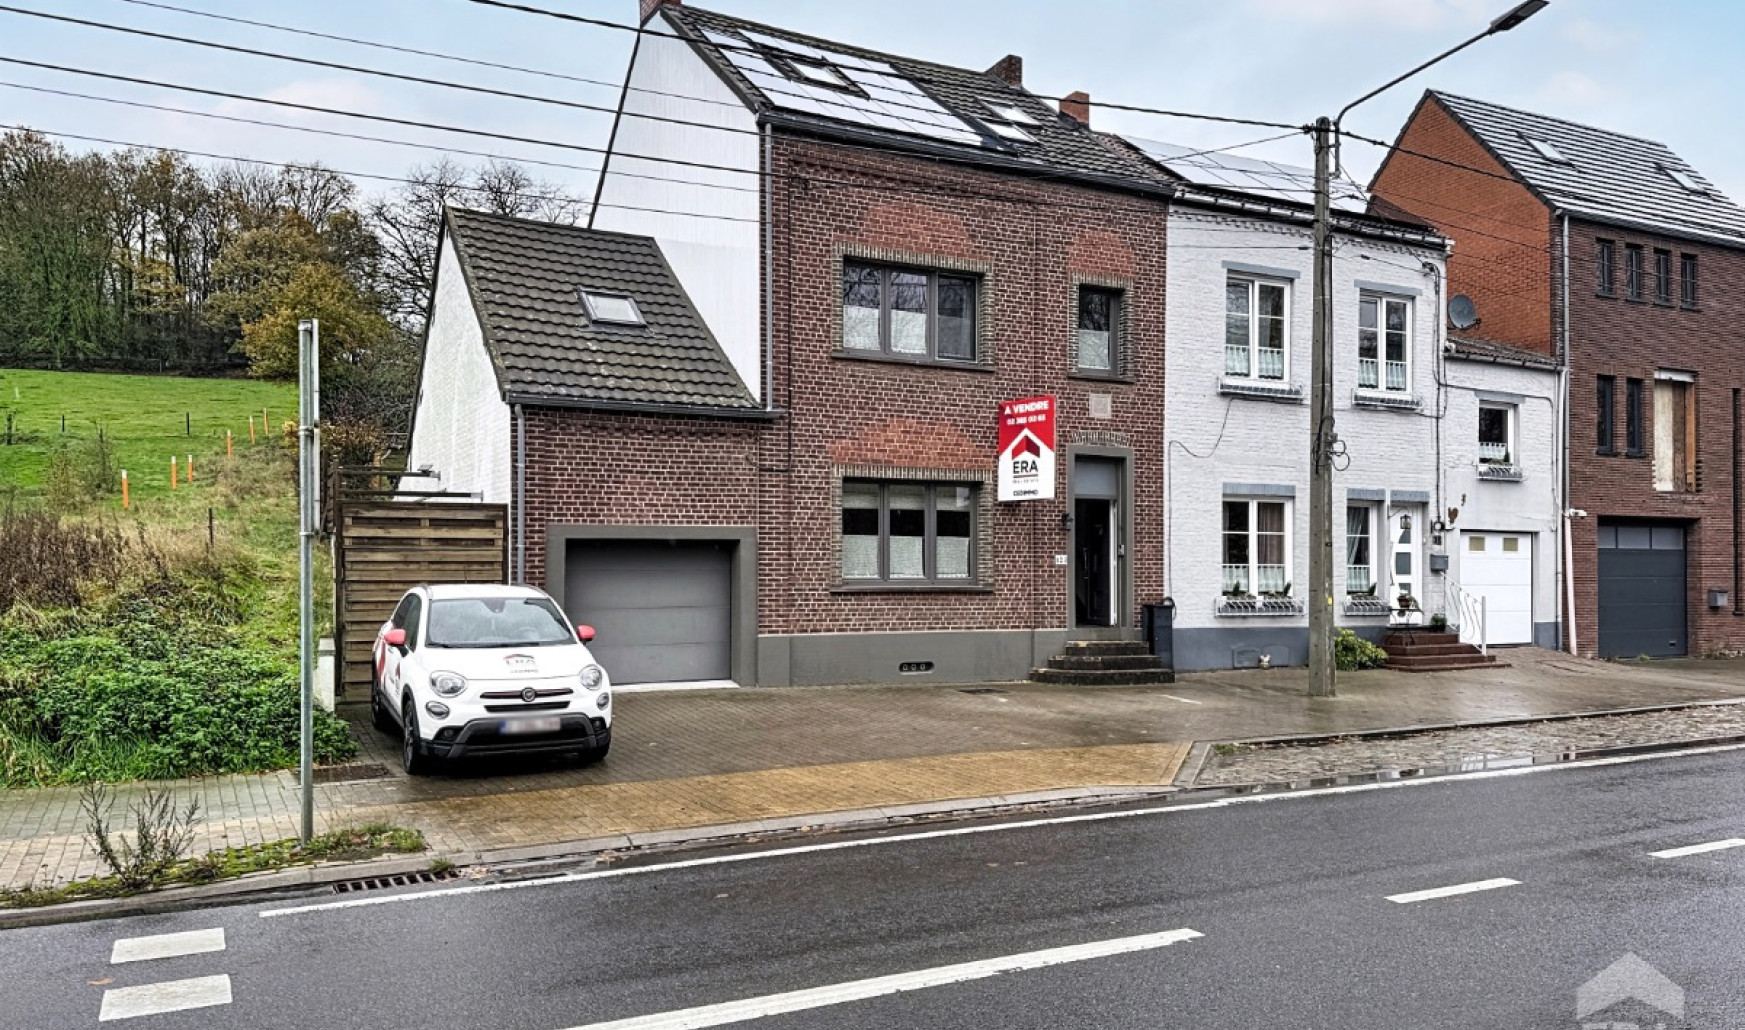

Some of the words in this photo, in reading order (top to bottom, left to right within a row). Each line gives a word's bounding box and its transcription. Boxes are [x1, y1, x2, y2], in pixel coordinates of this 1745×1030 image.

[1004, 405, 1011, 415] A
[1012, 401, 1049, 414] VENDRE
[1013, 460, 1038, 474] ERA
